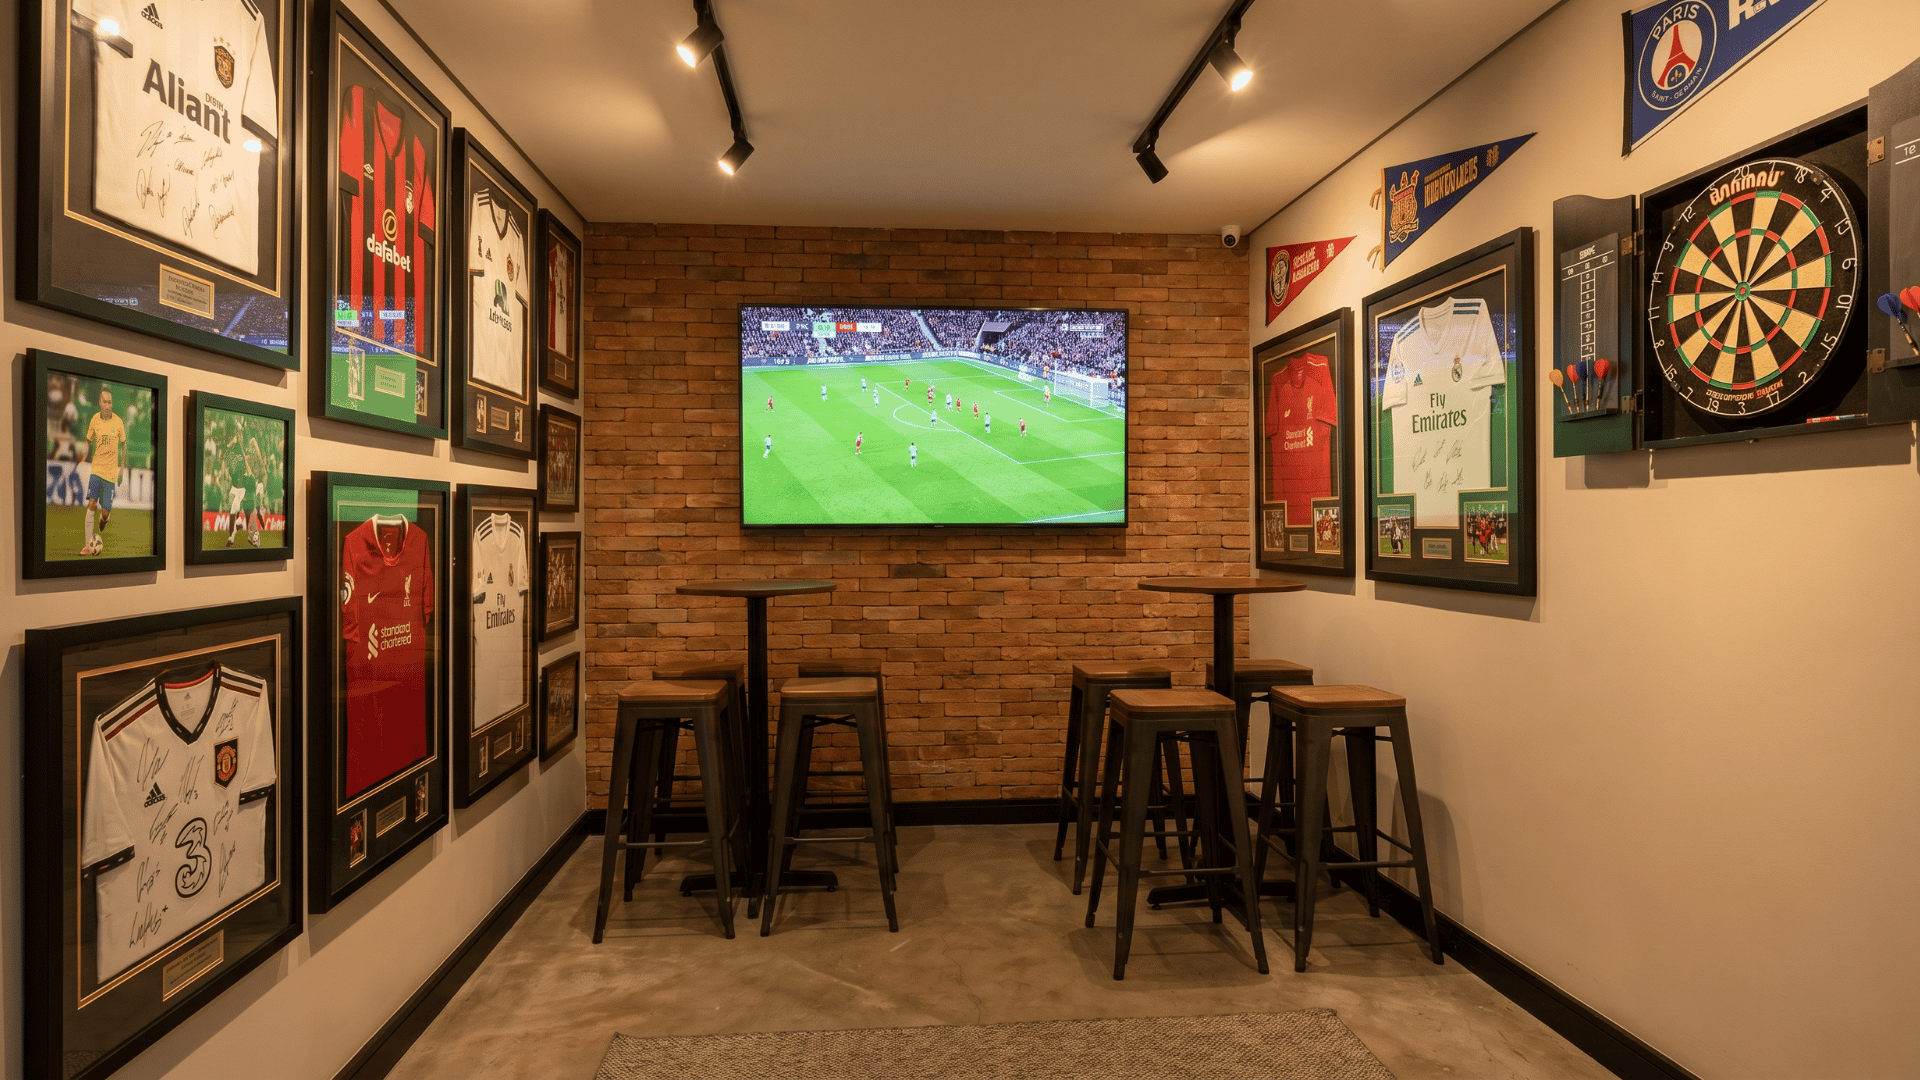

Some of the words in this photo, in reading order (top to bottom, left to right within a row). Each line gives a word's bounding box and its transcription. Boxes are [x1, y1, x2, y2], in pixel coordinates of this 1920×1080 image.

[1652, 3, 1700, 41] PARIS
[142, 58, 231, 145] Aliant
[1733, 164, 1750, 181] 20
[1820, 188, 1834, 203] 4
[1681, 206, 1696, 223] 12
[366, 233, 411, 273] dafabet
[1798, 371, 1808, 384] 2
[1737, 401, 1746, 415] 3
[1411, 409, 1467, 434] Emirates
[486, 608, 516, 629] Emirates
[381, 633, 412, 651] chartered
